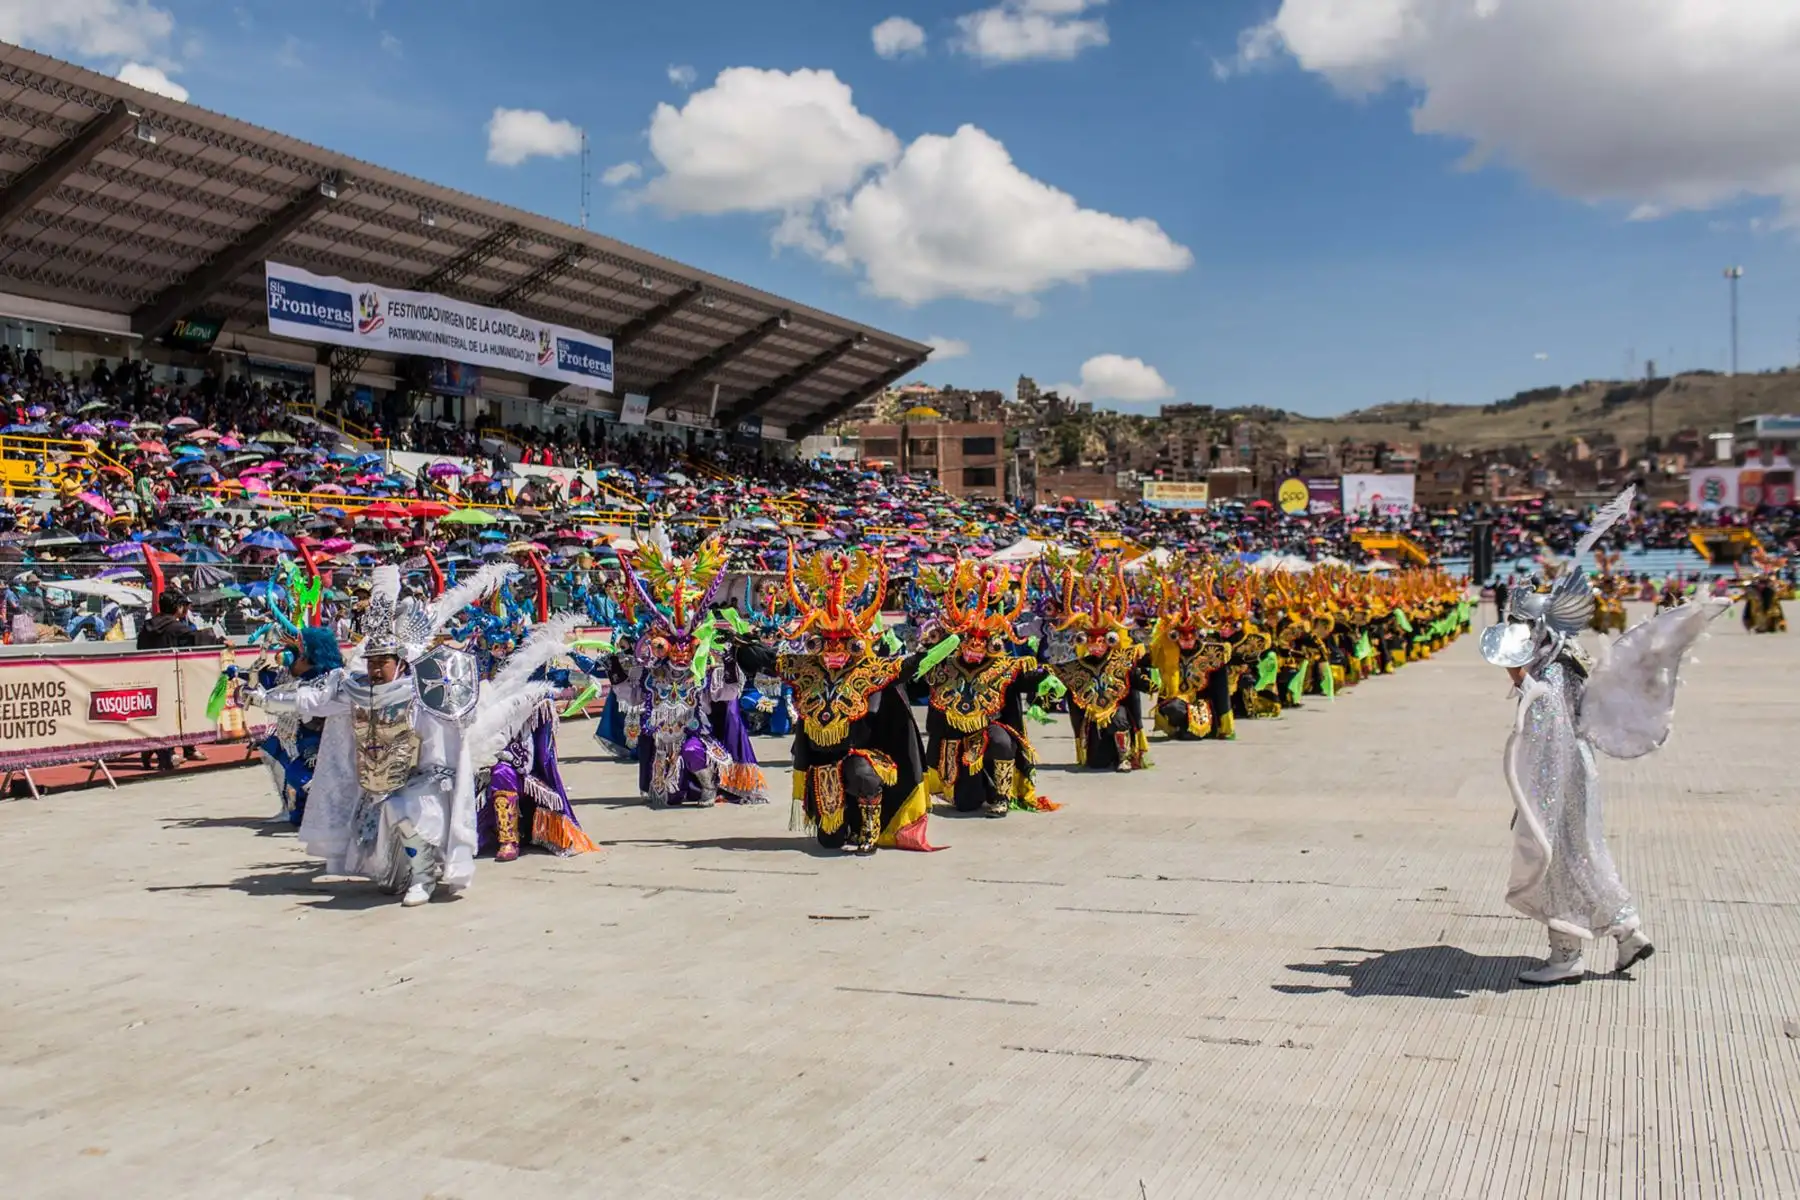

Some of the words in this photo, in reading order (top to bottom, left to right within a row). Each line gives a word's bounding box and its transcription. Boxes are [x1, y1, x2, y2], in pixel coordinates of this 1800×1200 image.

[270, 280, 286, 294] Sin
[270, 292, 352, 323] Fronteras
[388, 301, 439, 321] FESTIVIDAD
[439, 308, 465, 329] VIRGEN
[466, 316, 477, 331] DE
[479, 318, 490, 333] LA
[491, 320, 536, 343] CANDELARIA
[468, 339, 478, 352] DE
[479, 342, 489, 354] LA
[25, 464, 30, 474] 3
[0, 699, 72, 720] ELEBRAR
[95, 691, 153, 715] CUSQUEÑA
